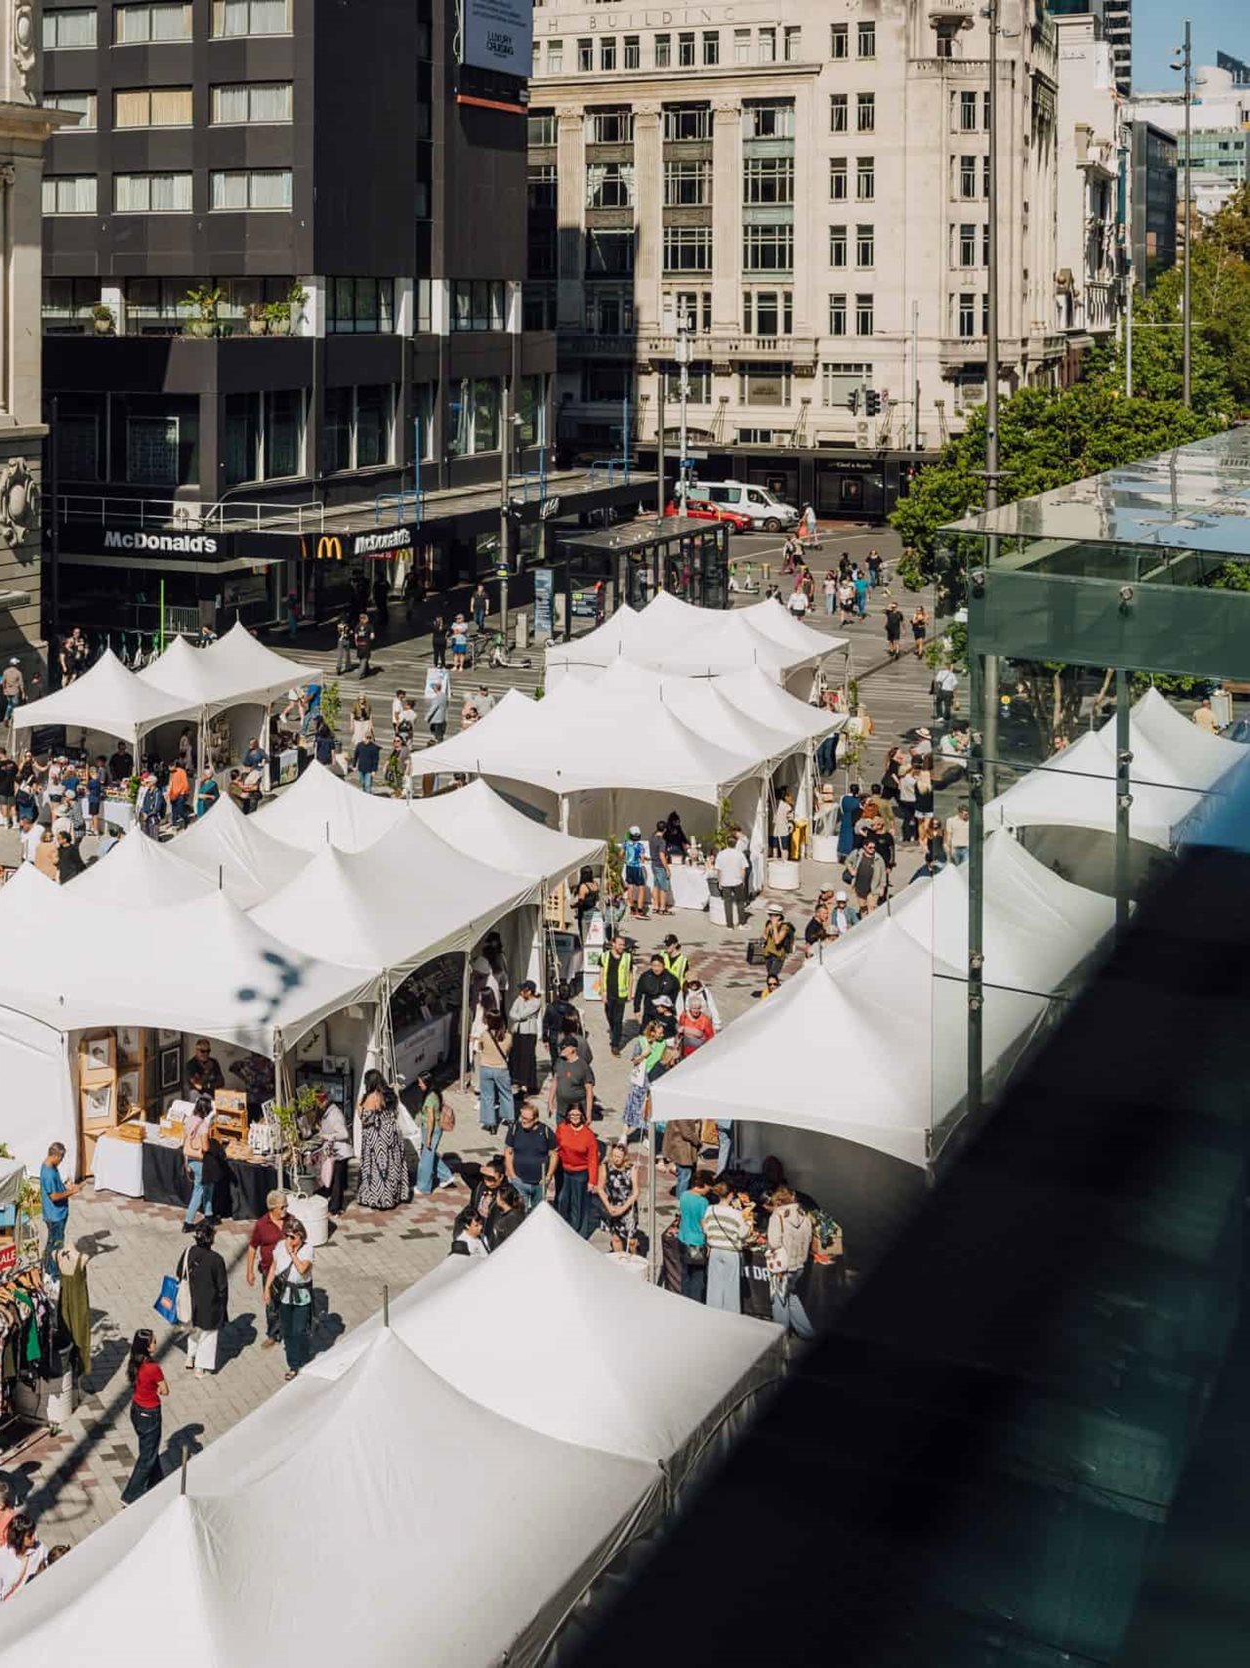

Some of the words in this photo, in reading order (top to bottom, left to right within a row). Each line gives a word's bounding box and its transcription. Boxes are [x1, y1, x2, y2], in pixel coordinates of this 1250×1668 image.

[588, 7, 736, 30] BUILDING
[104, 530, 217, 554] McDonald's
[354, 527, 411, 555] McDonald's
